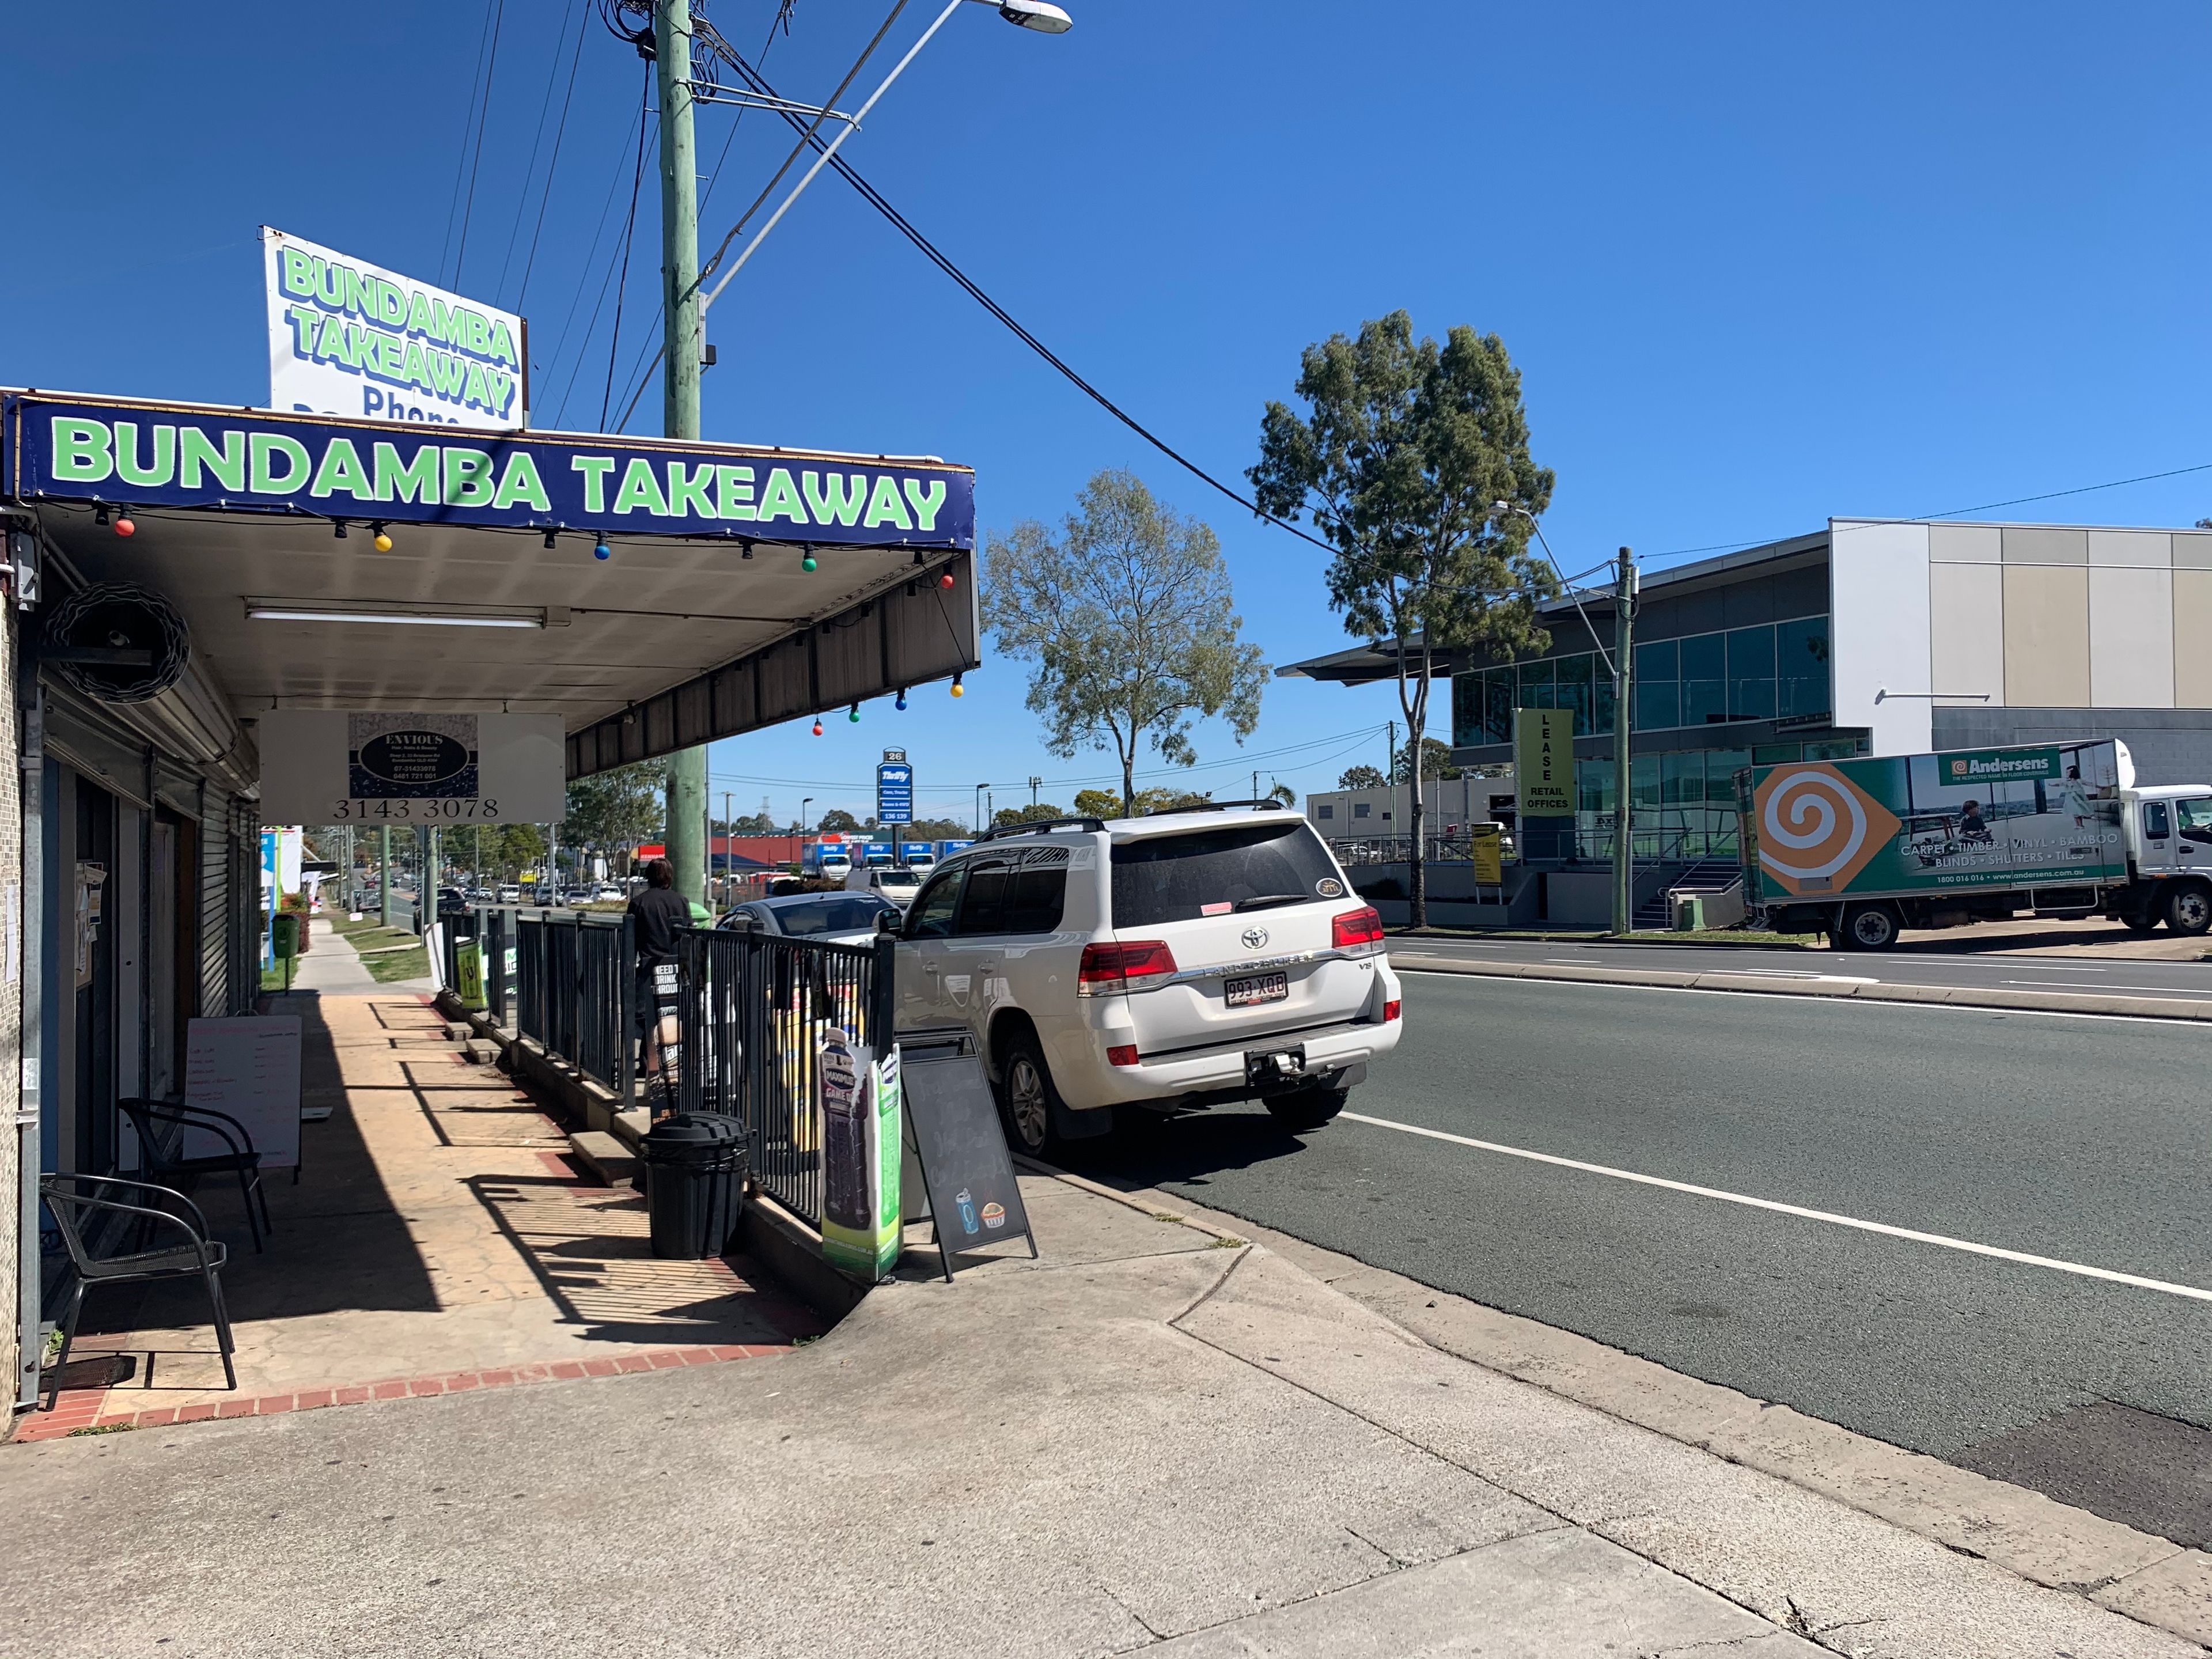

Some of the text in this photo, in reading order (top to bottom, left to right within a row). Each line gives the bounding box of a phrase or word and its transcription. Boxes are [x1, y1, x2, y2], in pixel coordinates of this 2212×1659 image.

[277, 245, 519, 373] BUNDAMBA
[285, 304, 515, 420] TAKEAWAY
[51, 416, 946, 531] BUNDAMBA TAKEAWAY
[386, 734, 443, 744] ENVIOUS
[1541, 714, 1551, 781] LEASE
[888, 752, 902, 760] 26
[1969, 758, 2049, 774] Andersens
[882, 771, 908, 782] Thrifty
[1531, 787, 1564, 796] RETAIL
[333, 798, 498, 819] 3143 3078
[1528, 799, 1568, 808] OFFICES
[1901, 834, 2118, 856] CARPET TIMBER VINYL BAMBOO
[1936, 857, 1977, 869] BLINDS
[1988, 853, 2044, 865] SHUTTERS
[1956, 874, 1969, 882] 016
[1971, 874, 1984, 882] 016
[1993, 870, 2084, 880] www.andersens.com.au
[654, 974, 677, 985] DRINK
[827, 1070, 854, 1085] MAXIMUS
[826, 1088, 846, 1100] GAME
